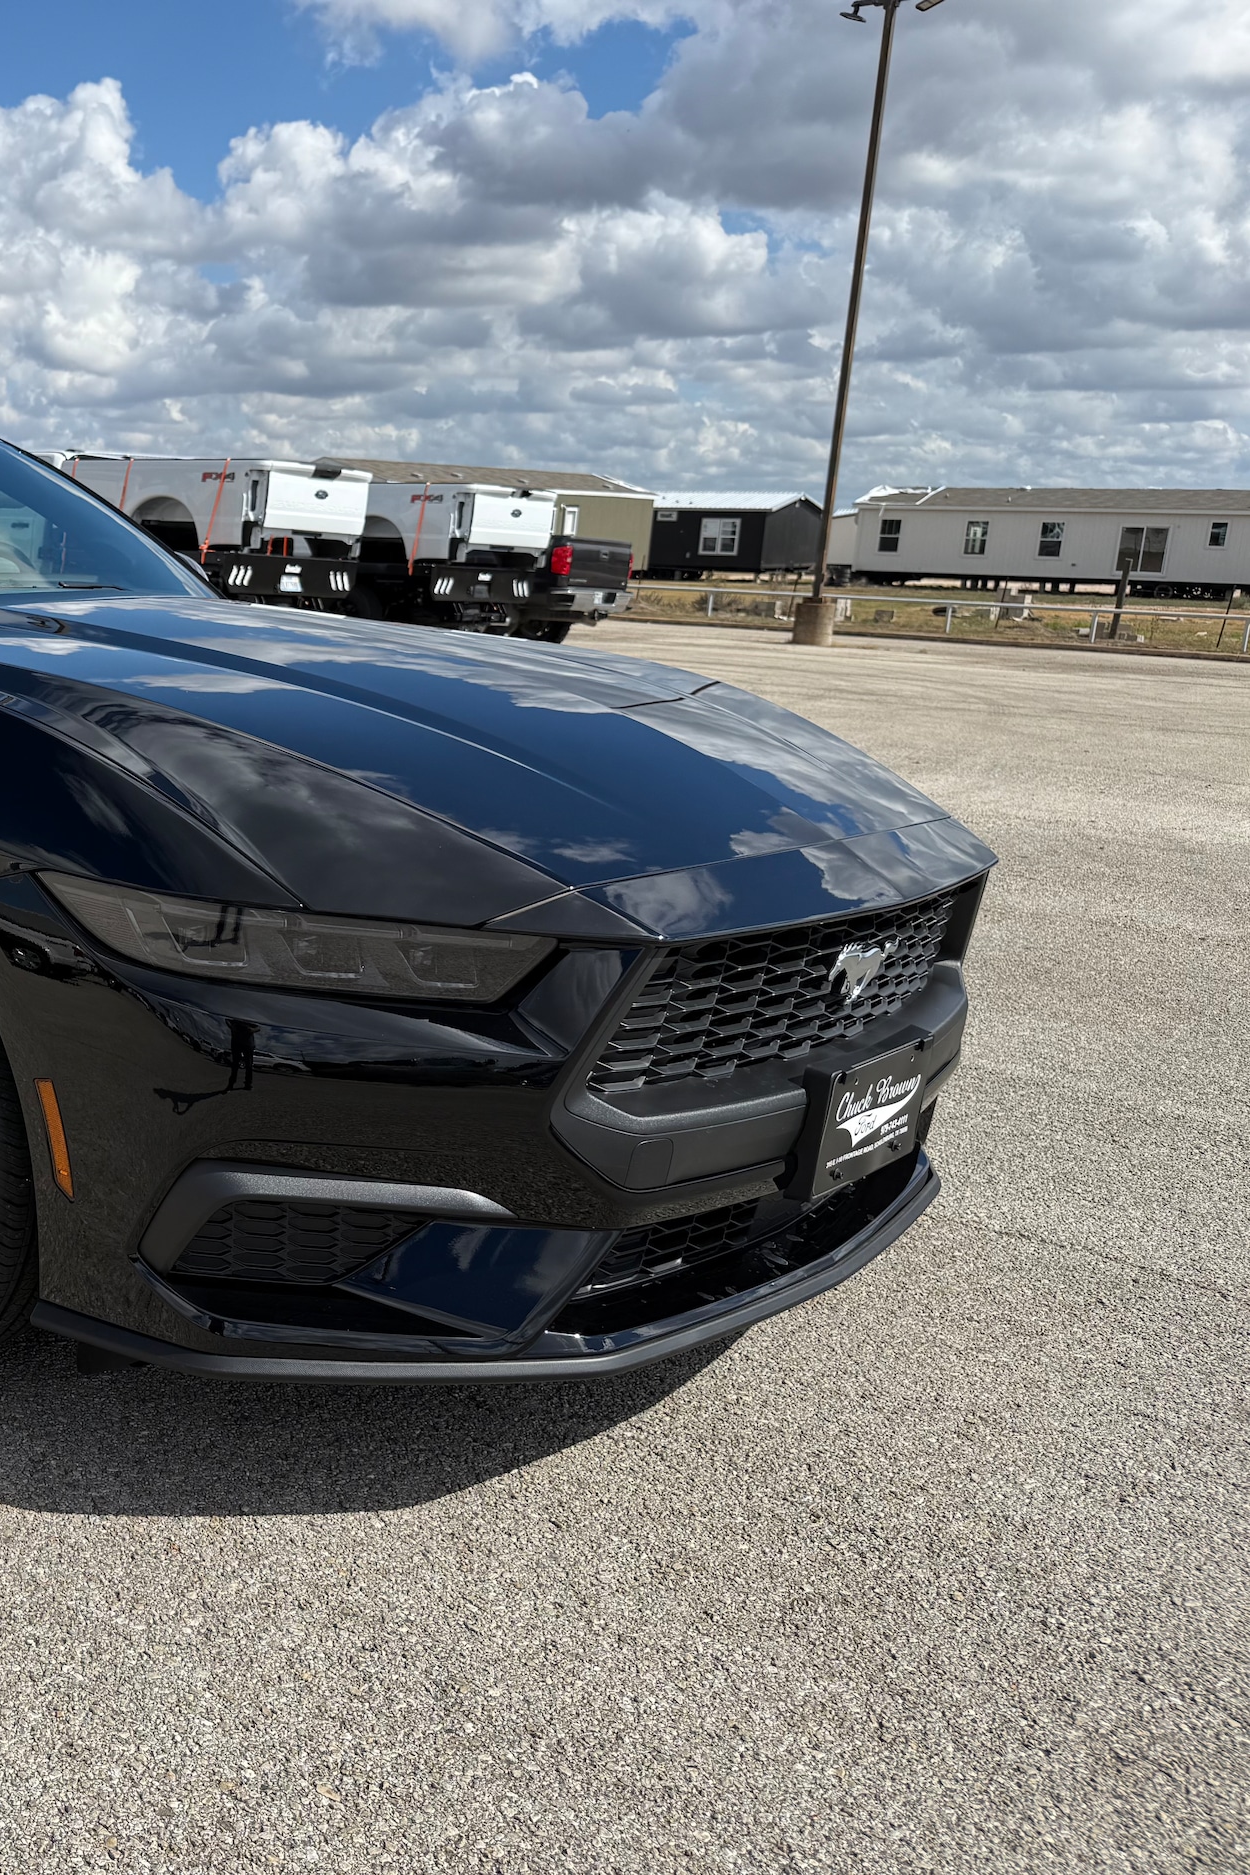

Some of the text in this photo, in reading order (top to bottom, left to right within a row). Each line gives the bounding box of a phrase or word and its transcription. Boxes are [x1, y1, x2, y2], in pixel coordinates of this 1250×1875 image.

[836, 1074, 920, 1122] Chuck Brown
[854, 1112, 878, 1137] Ford
